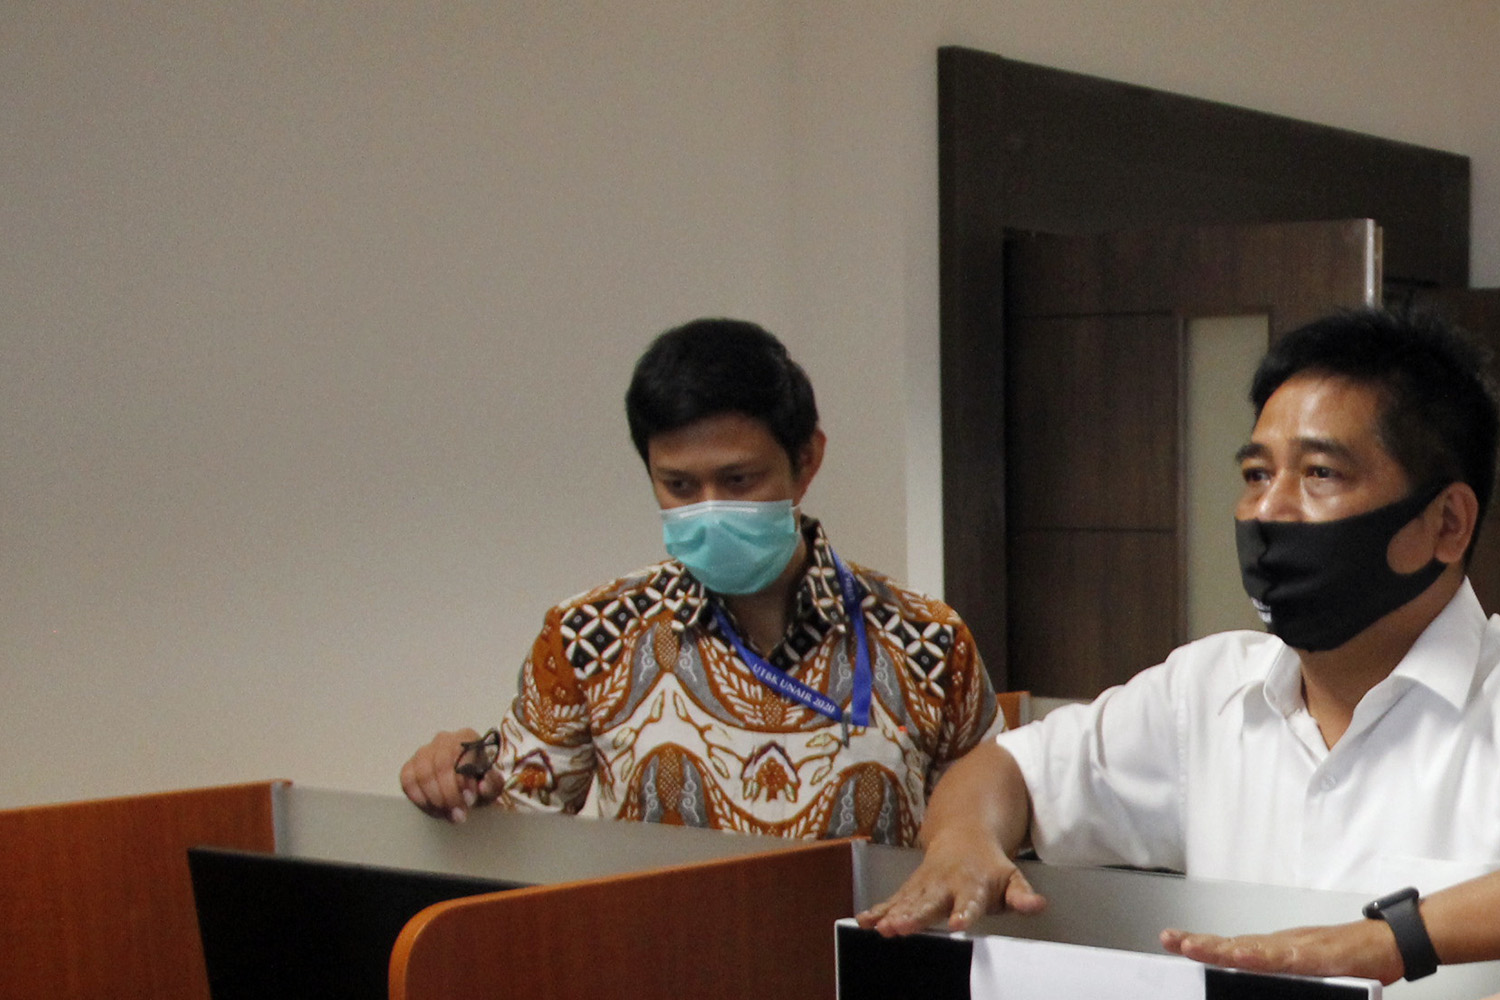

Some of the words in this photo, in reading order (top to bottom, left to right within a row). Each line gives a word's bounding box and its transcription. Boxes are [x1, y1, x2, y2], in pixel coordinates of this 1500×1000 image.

[752, 663, 778, 686] UTBK
[780, 679, 813, 703] UNAIR
[812, 698, 836, 714] 2020
